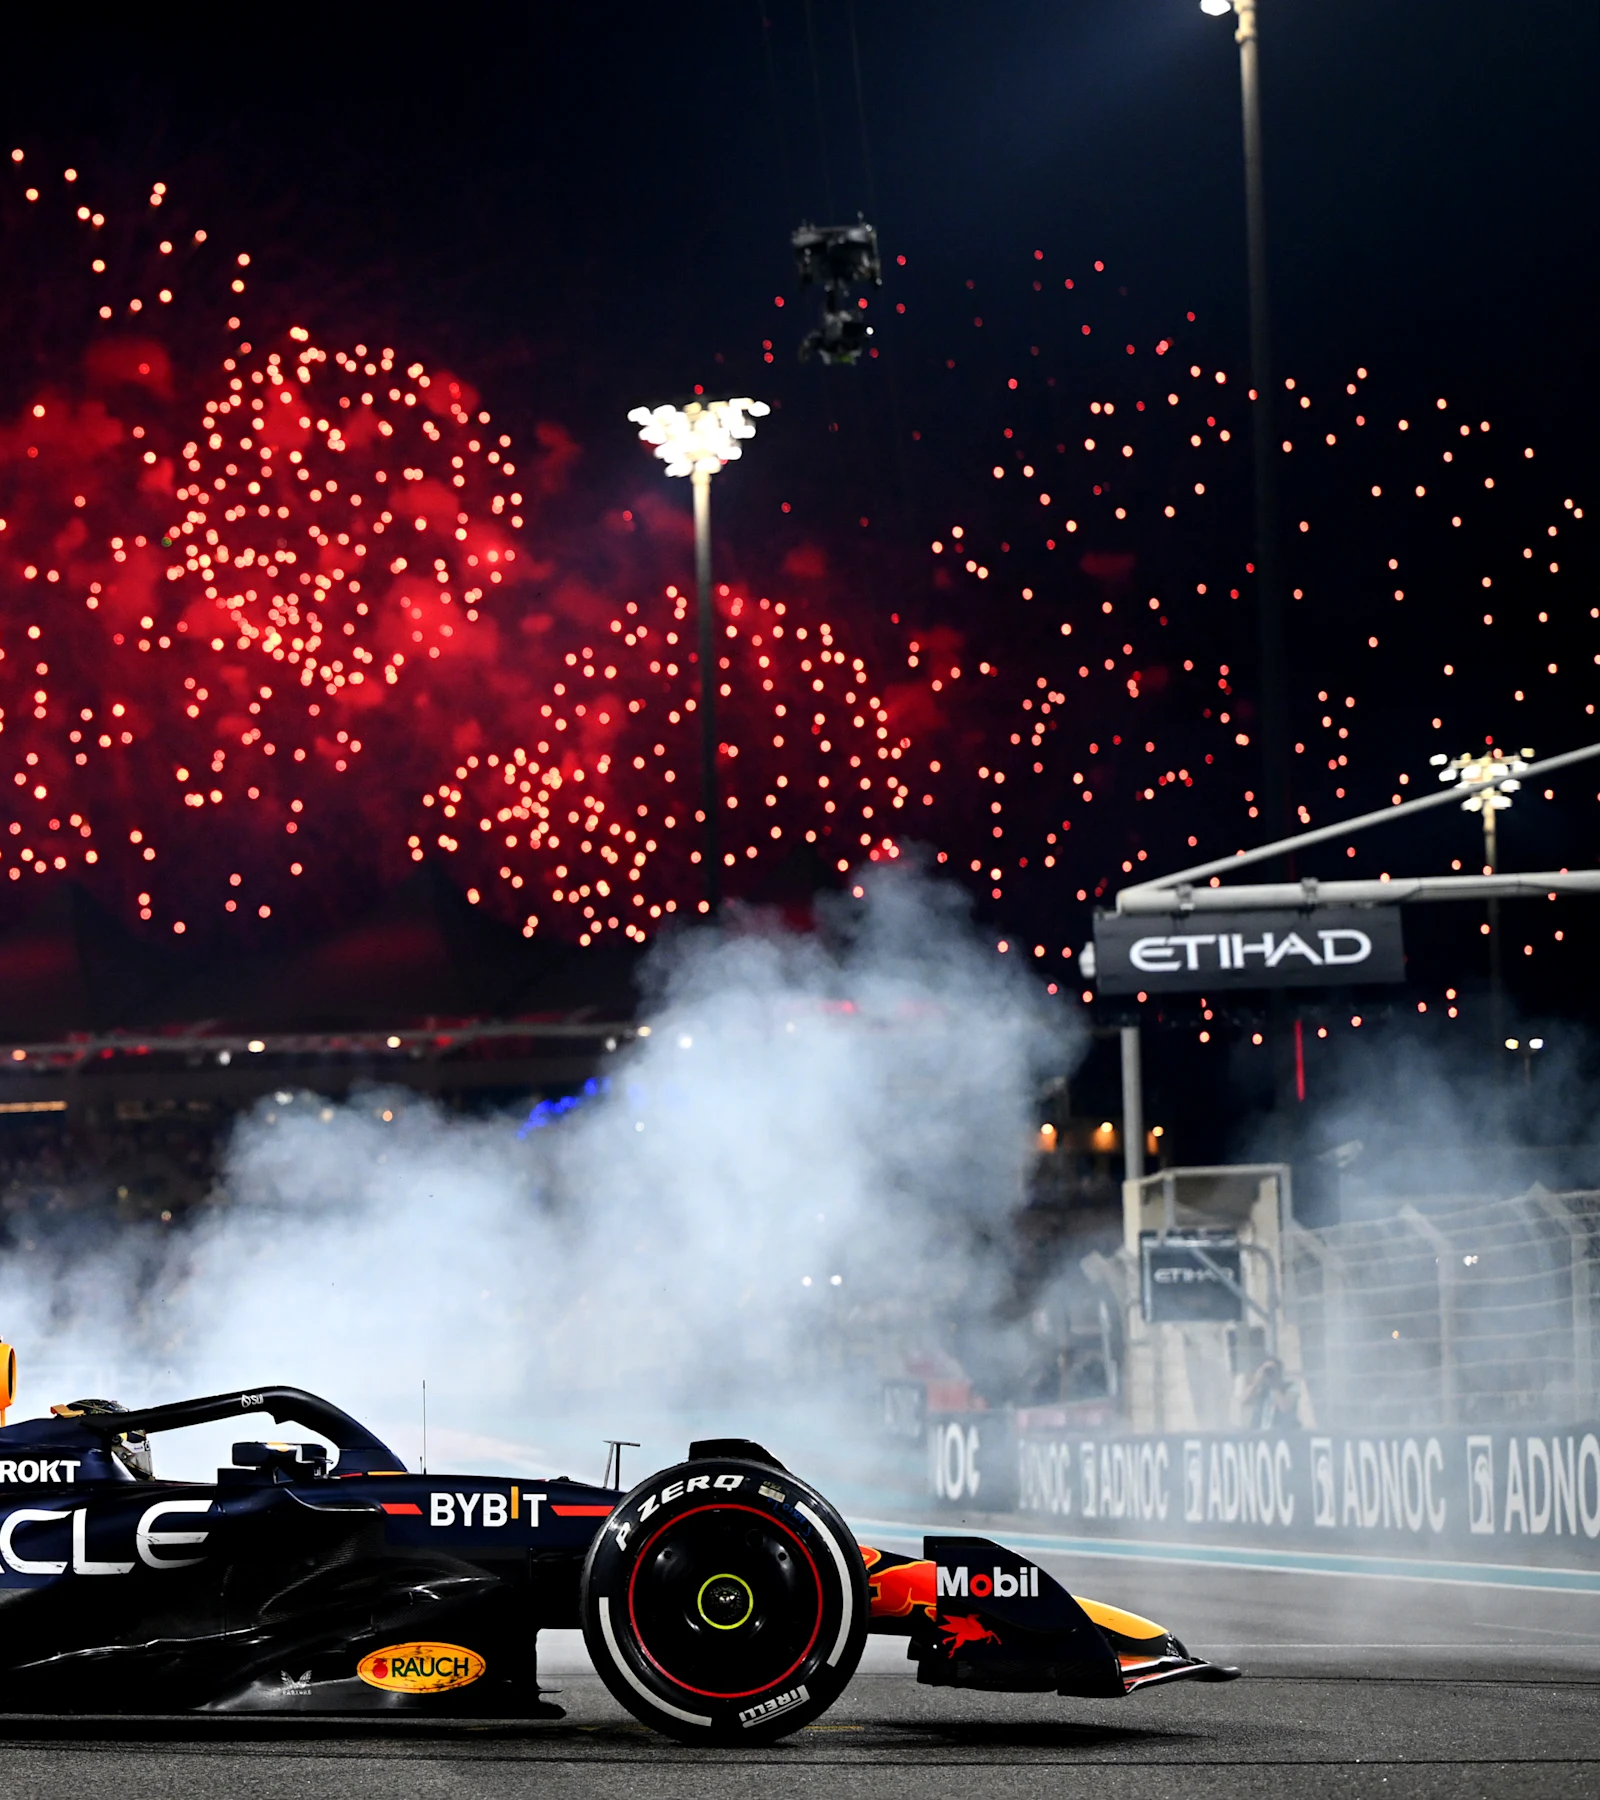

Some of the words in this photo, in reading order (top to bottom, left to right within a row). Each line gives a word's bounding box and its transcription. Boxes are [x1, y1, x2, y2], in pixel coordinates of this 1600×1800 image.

[1129, 929, 1372, 972] ETIHAD
[1101, 1441, 1169, 1520] ADNOC
[1208, 1439, 1293, 1525] ADNOC
[1343, 1437, 1446, 1533] ADNOC
[430, 1486, 547, 1527] BYBIT
[615, 1522, 631, 1551] P
[937, 1567, 1038, 1597] Mobil
[391, 1657, 469, 1677] RAUCH
[739, 1684, 811, 1728] PIRELLI
